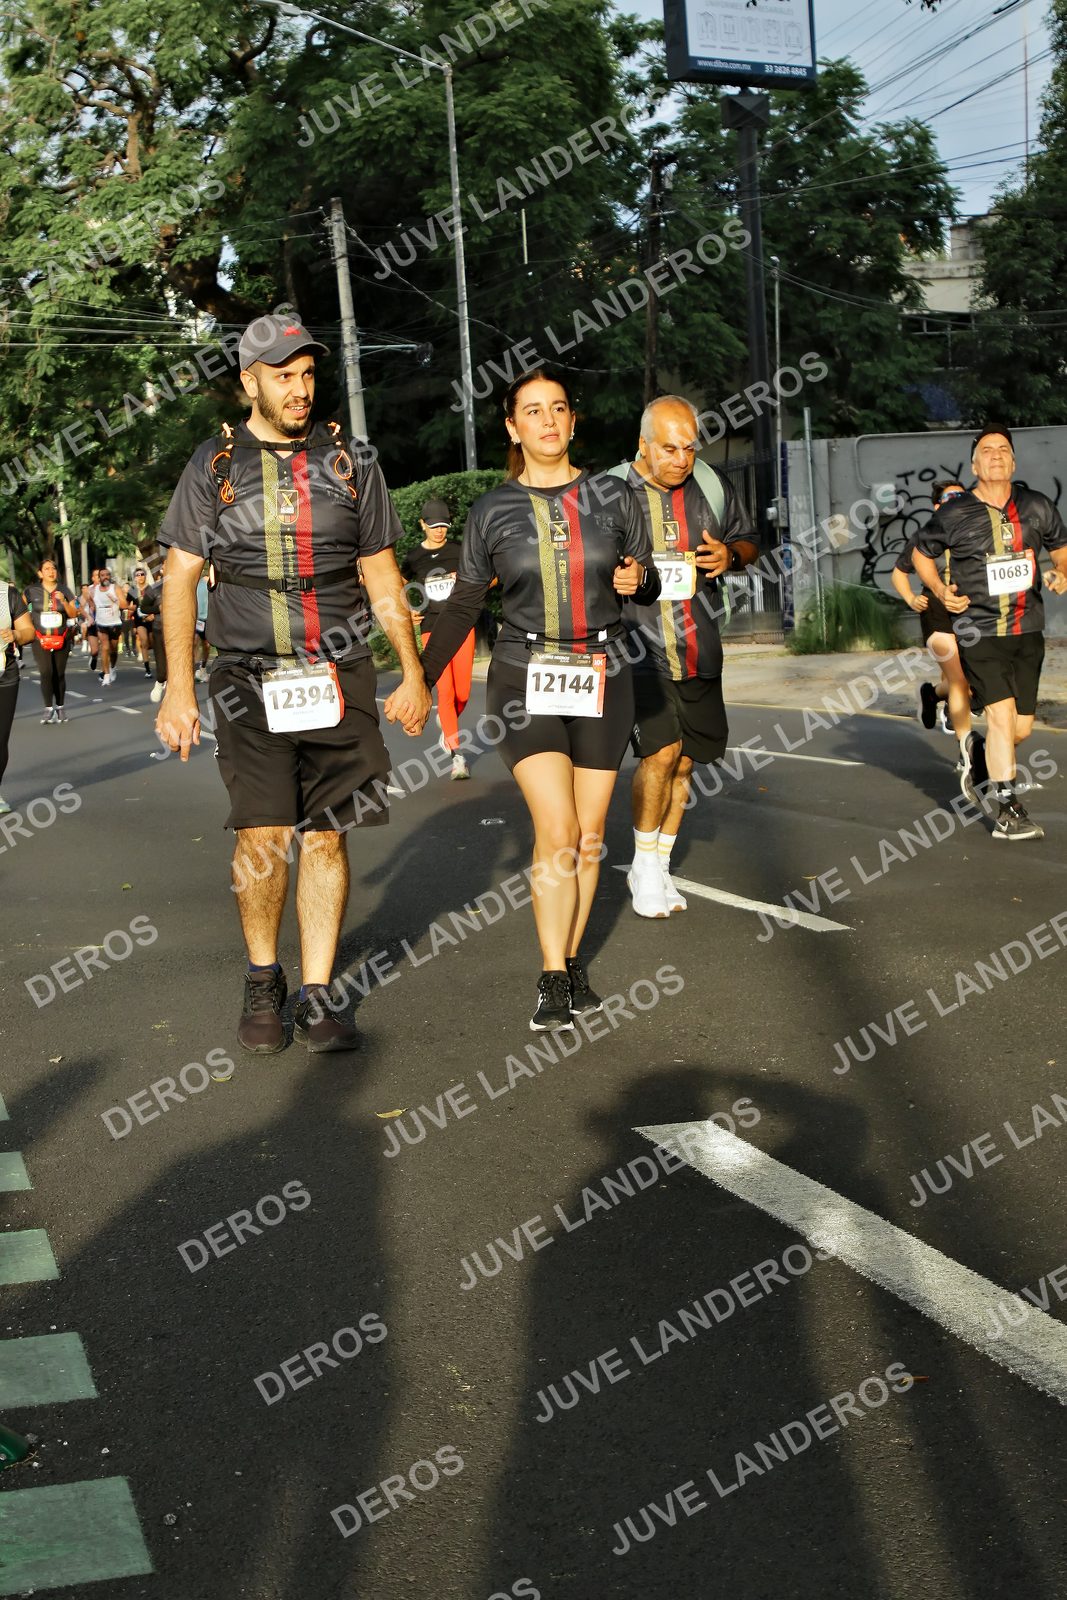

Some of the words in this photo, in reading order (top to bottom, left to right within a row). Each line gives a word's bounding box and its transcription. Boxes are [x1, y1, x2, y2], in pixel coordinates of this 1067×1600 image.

[764, 64, 773, 73] 33
[991, 564, 1029, 580] 10683
[532, 672, 594, 694] 12144
[268, 684, 335, 710] 12394
